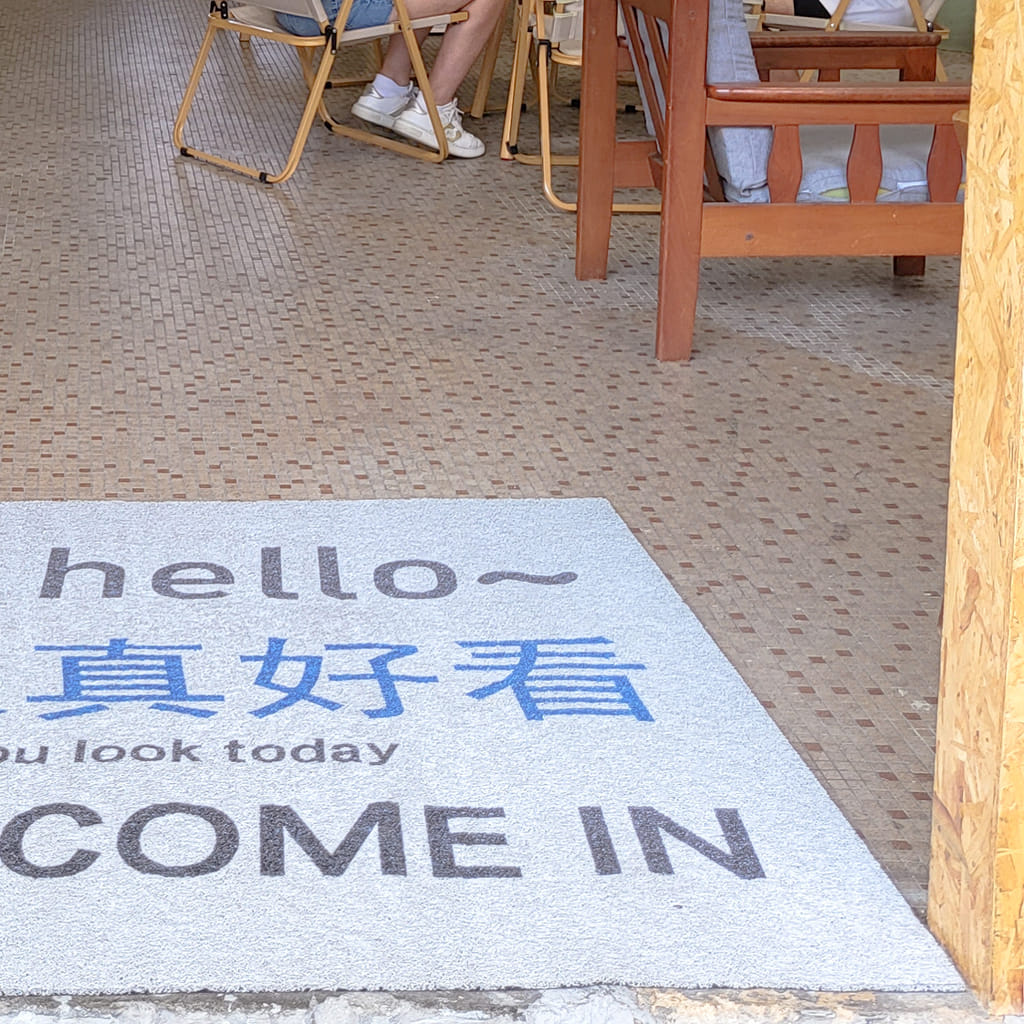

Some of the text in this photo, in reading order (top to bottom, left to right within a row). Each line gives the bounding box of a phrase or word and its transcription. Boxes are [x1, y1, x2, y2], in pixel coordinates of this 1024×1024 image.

[74, 740, 199, 764] look
[226, 739, 398, 765] today
[580, 807, 765, 880] IN
